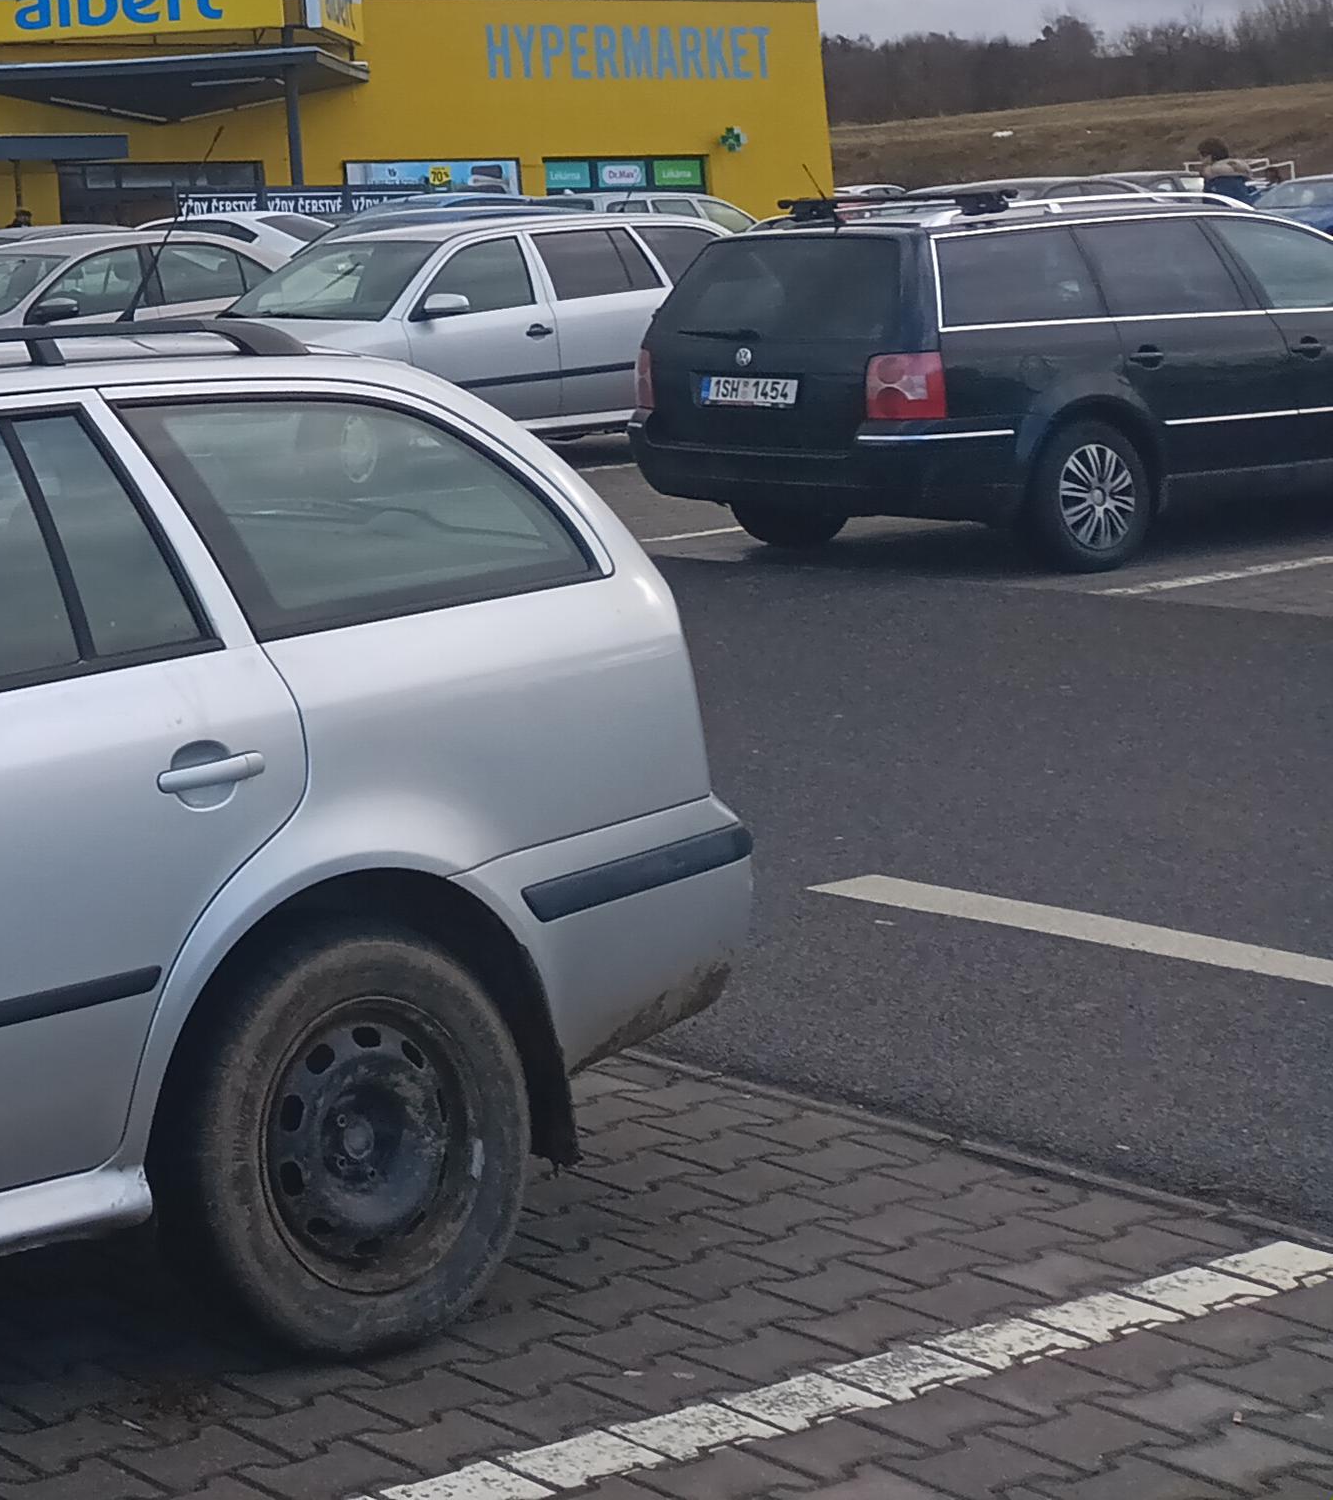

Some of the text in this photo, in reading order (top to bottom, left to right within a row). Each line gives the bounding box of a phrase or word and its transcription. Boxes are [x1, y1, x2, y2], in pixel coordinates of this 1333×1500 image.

[485, 23, 771, 80] HYPERMARKET
[267, 197, 342, 213] VŽDY ČERSTVÉ
[713, 379, 789, 400] 1SH 1454
